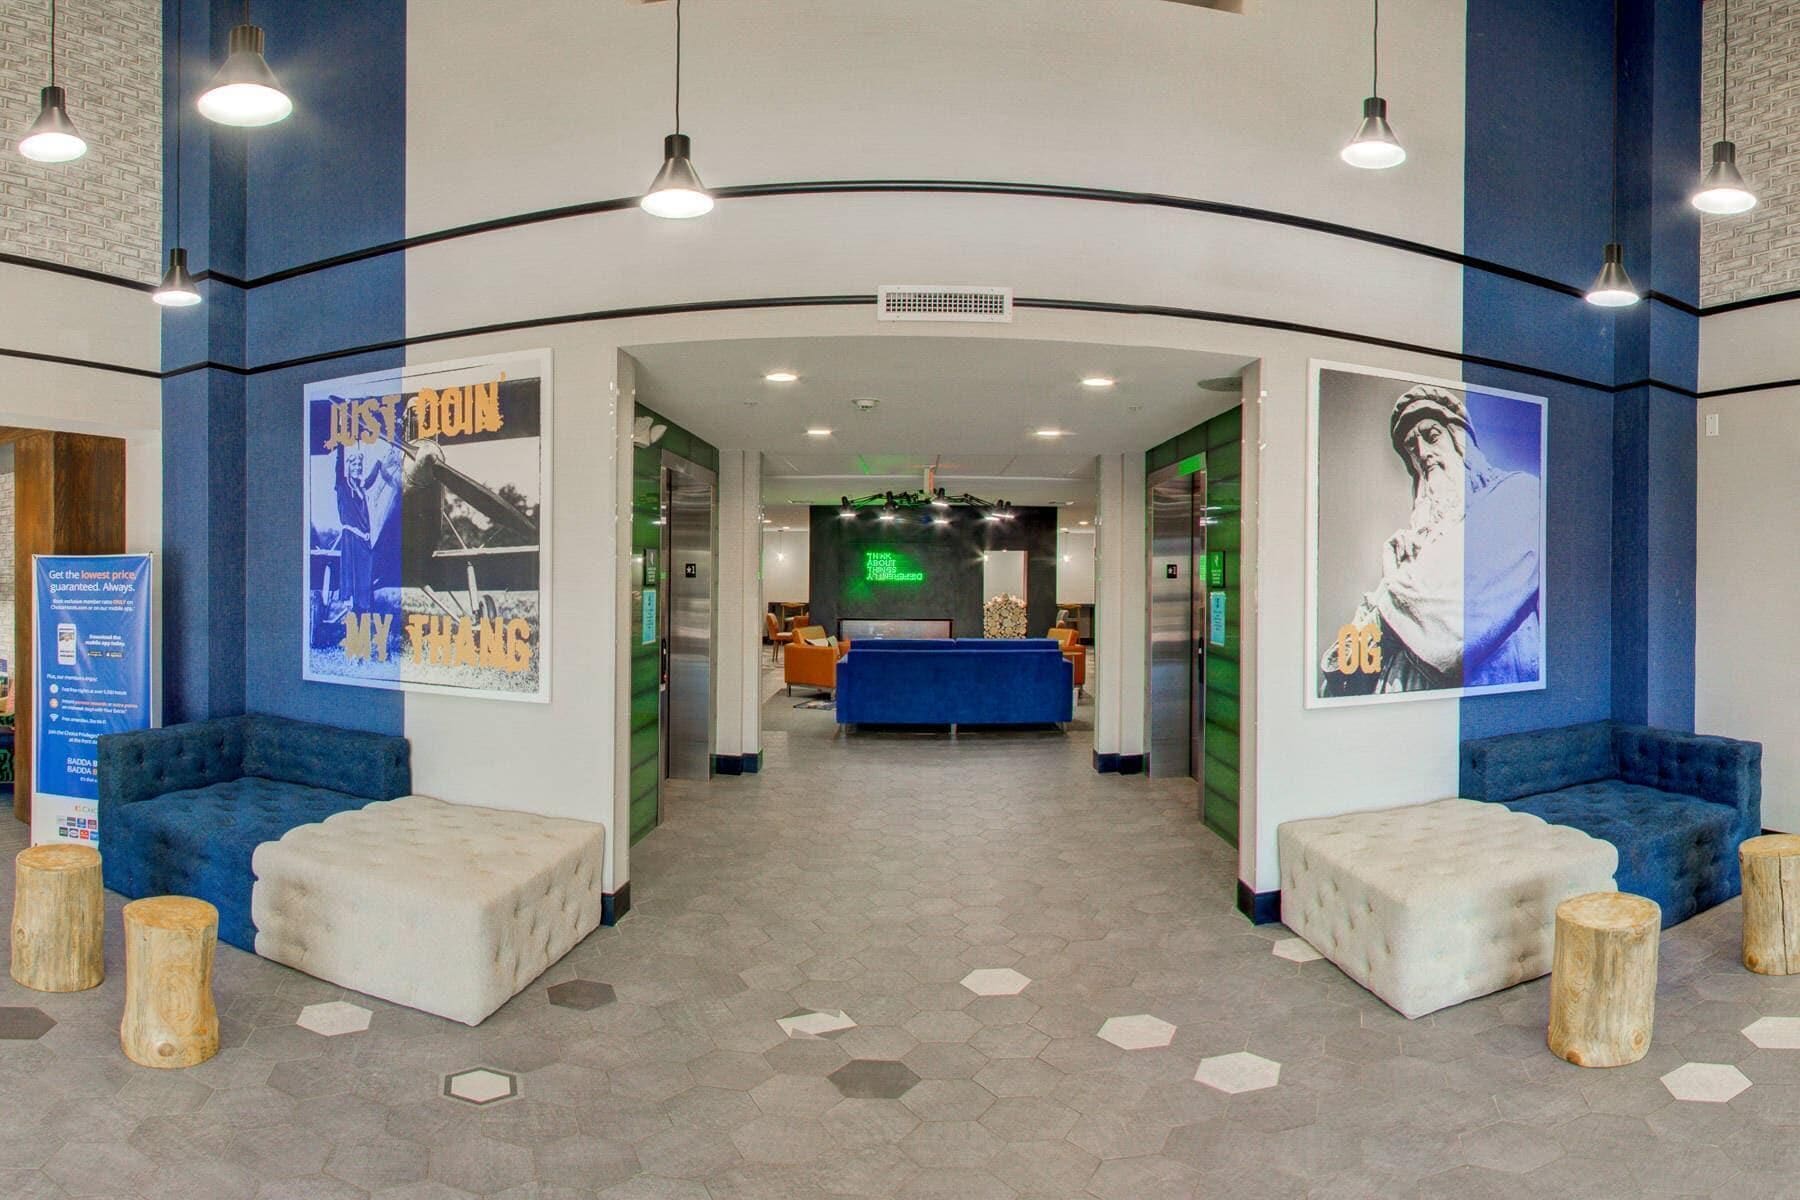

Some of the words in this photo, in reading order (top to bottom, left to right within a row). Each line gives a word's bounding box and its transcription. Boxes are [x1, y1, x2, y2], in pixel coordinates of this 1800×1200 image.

[324, 394, 402, 450] JUST
[866, 552, 892, 560] THINK
[49, 570, 64, 580] Get
[65, 569, 80, 580] the
[81, 570, 110, 580] lowest
[866, 566, 897, 574] THINGS
[49, 582, 101, 594] guaranteed.
[103, 582, 135, 594] Always.
[340, 612, 393, 663] MY
[405, 614, 532, 674] THANG
[1337, 623, 1382, 675] OG
[67, 757, 92, 767] BADDA
[67, 766, 92, 775] BADDA
